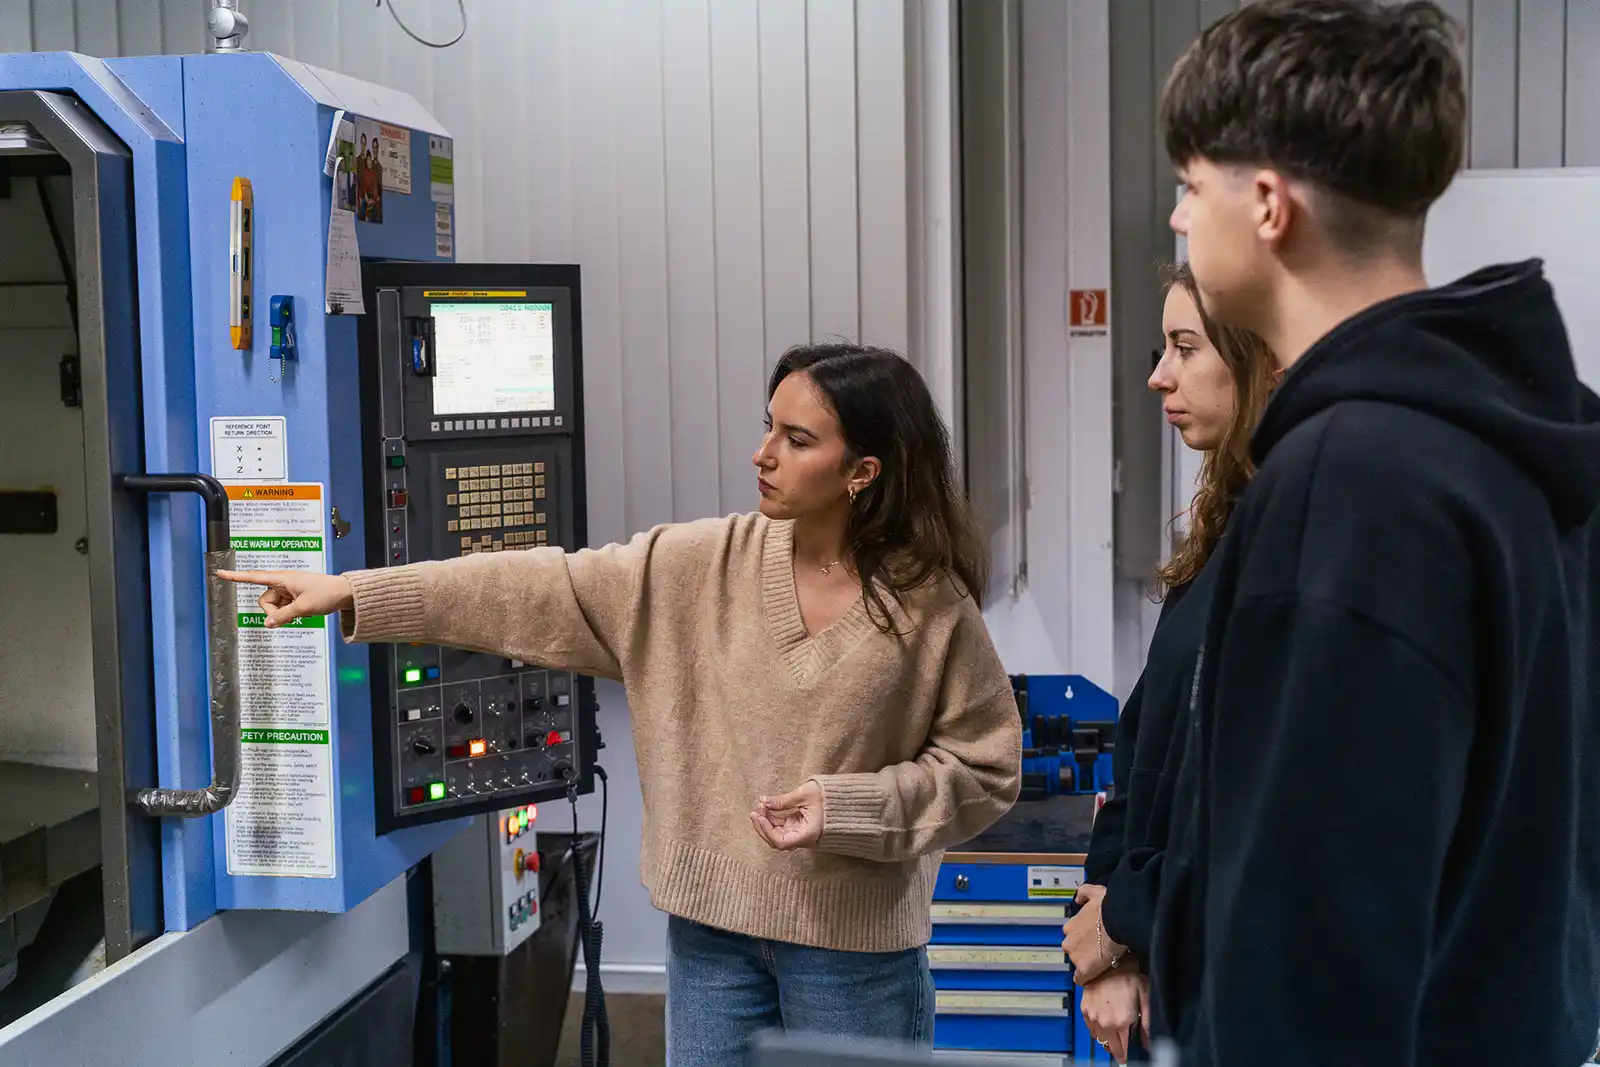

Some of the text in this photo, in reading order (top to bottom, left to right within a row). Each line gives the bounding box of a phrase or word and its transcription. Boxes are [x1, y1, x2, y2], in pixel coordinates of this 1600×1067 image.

[236, 445, 243, 453] X
[237, 466, 243, 474] Z
[255, 488, 295, 497] WARNING
[230, 540, 320, 549] NDLE WARM UP OPERATION
[240, 732, 324, 741] FETY PRECAUTION
